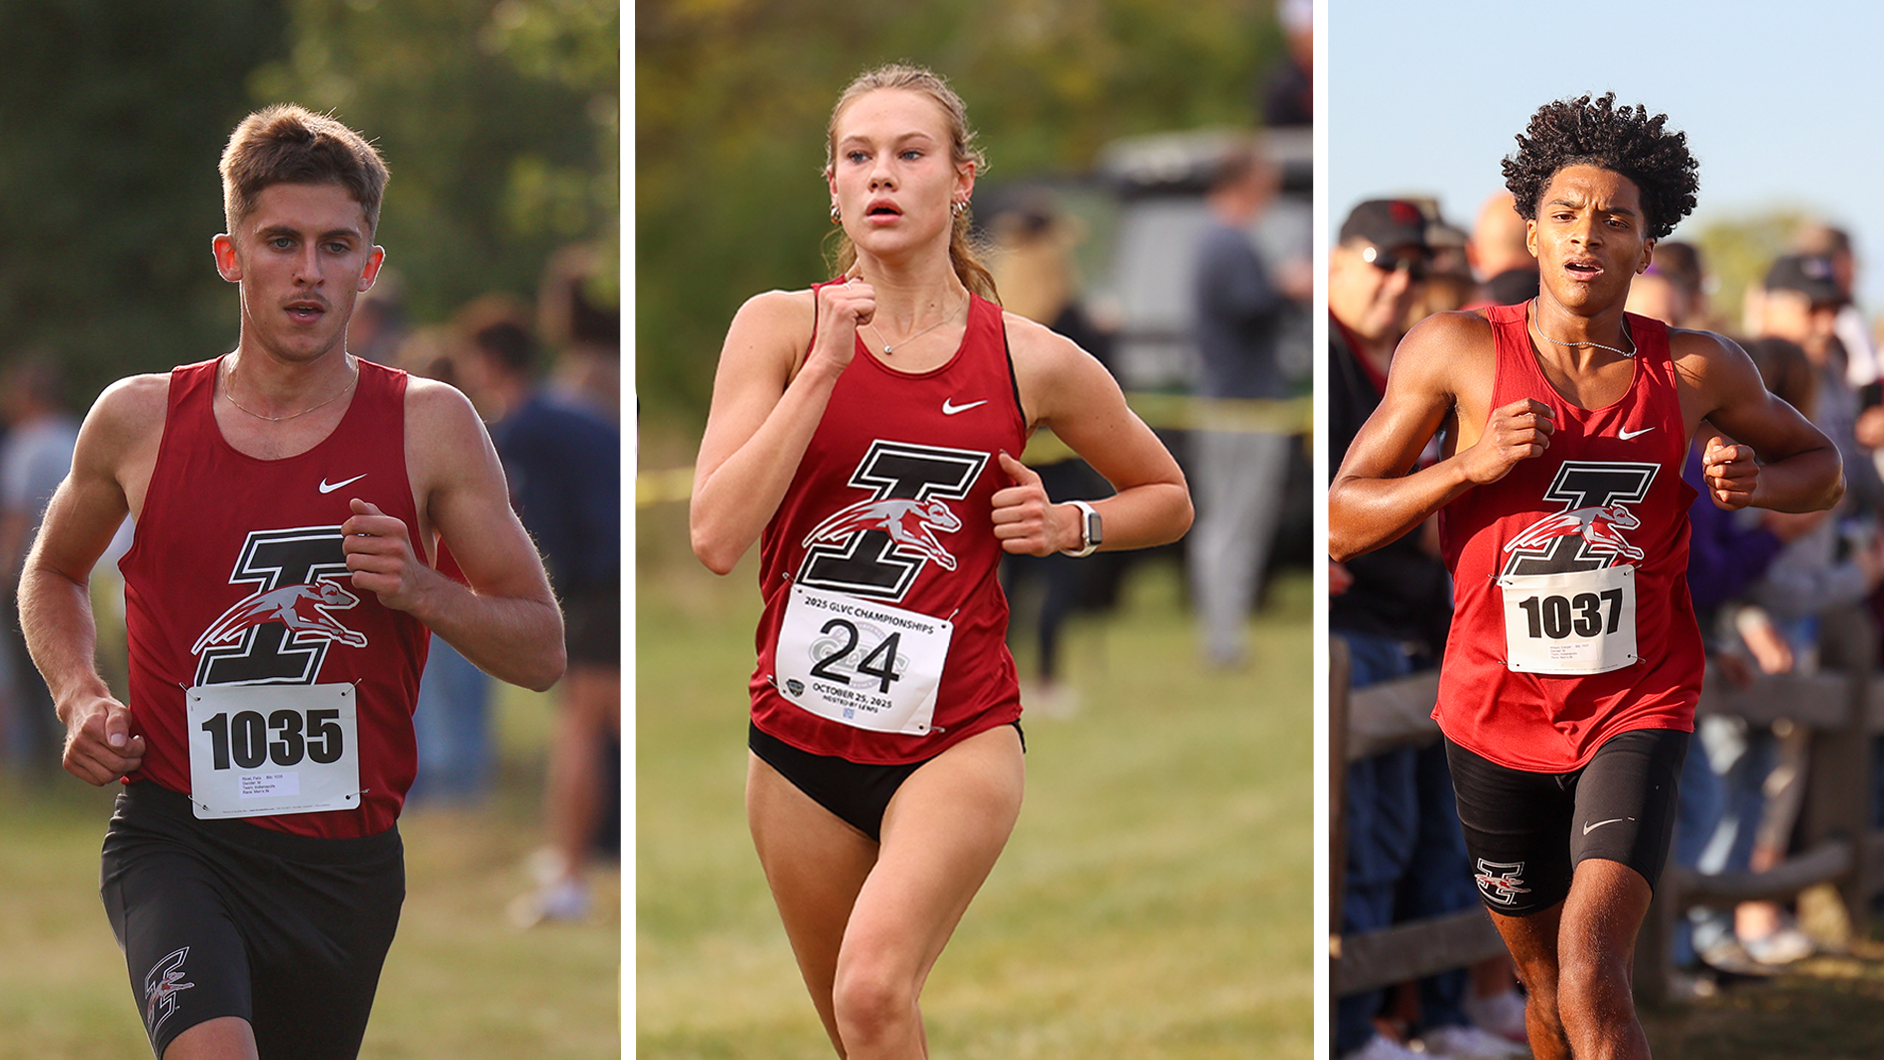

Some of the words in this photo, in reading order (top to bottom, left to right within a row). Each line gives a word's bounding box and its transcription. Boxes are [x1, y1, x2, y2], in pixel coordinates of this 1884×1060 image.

[804, 596, 828, 609] 2025
[829, 602, 854, 616] GLVC
[854, 608, 935, 635] CHAMPIONSHIPS
[1518, 587, 1623, 640] 1037
[809, 618, 902, 694] 24
[812, 682, 855, 700] OCTOBER
[855, 693, 869, 704] 25,
[870, 697, 893, 709] 2025
[823, 695, 848, 706] HOSTED
[858, 702, 879, 713] LEWIS
[201, 708, 344, 771] 1035
